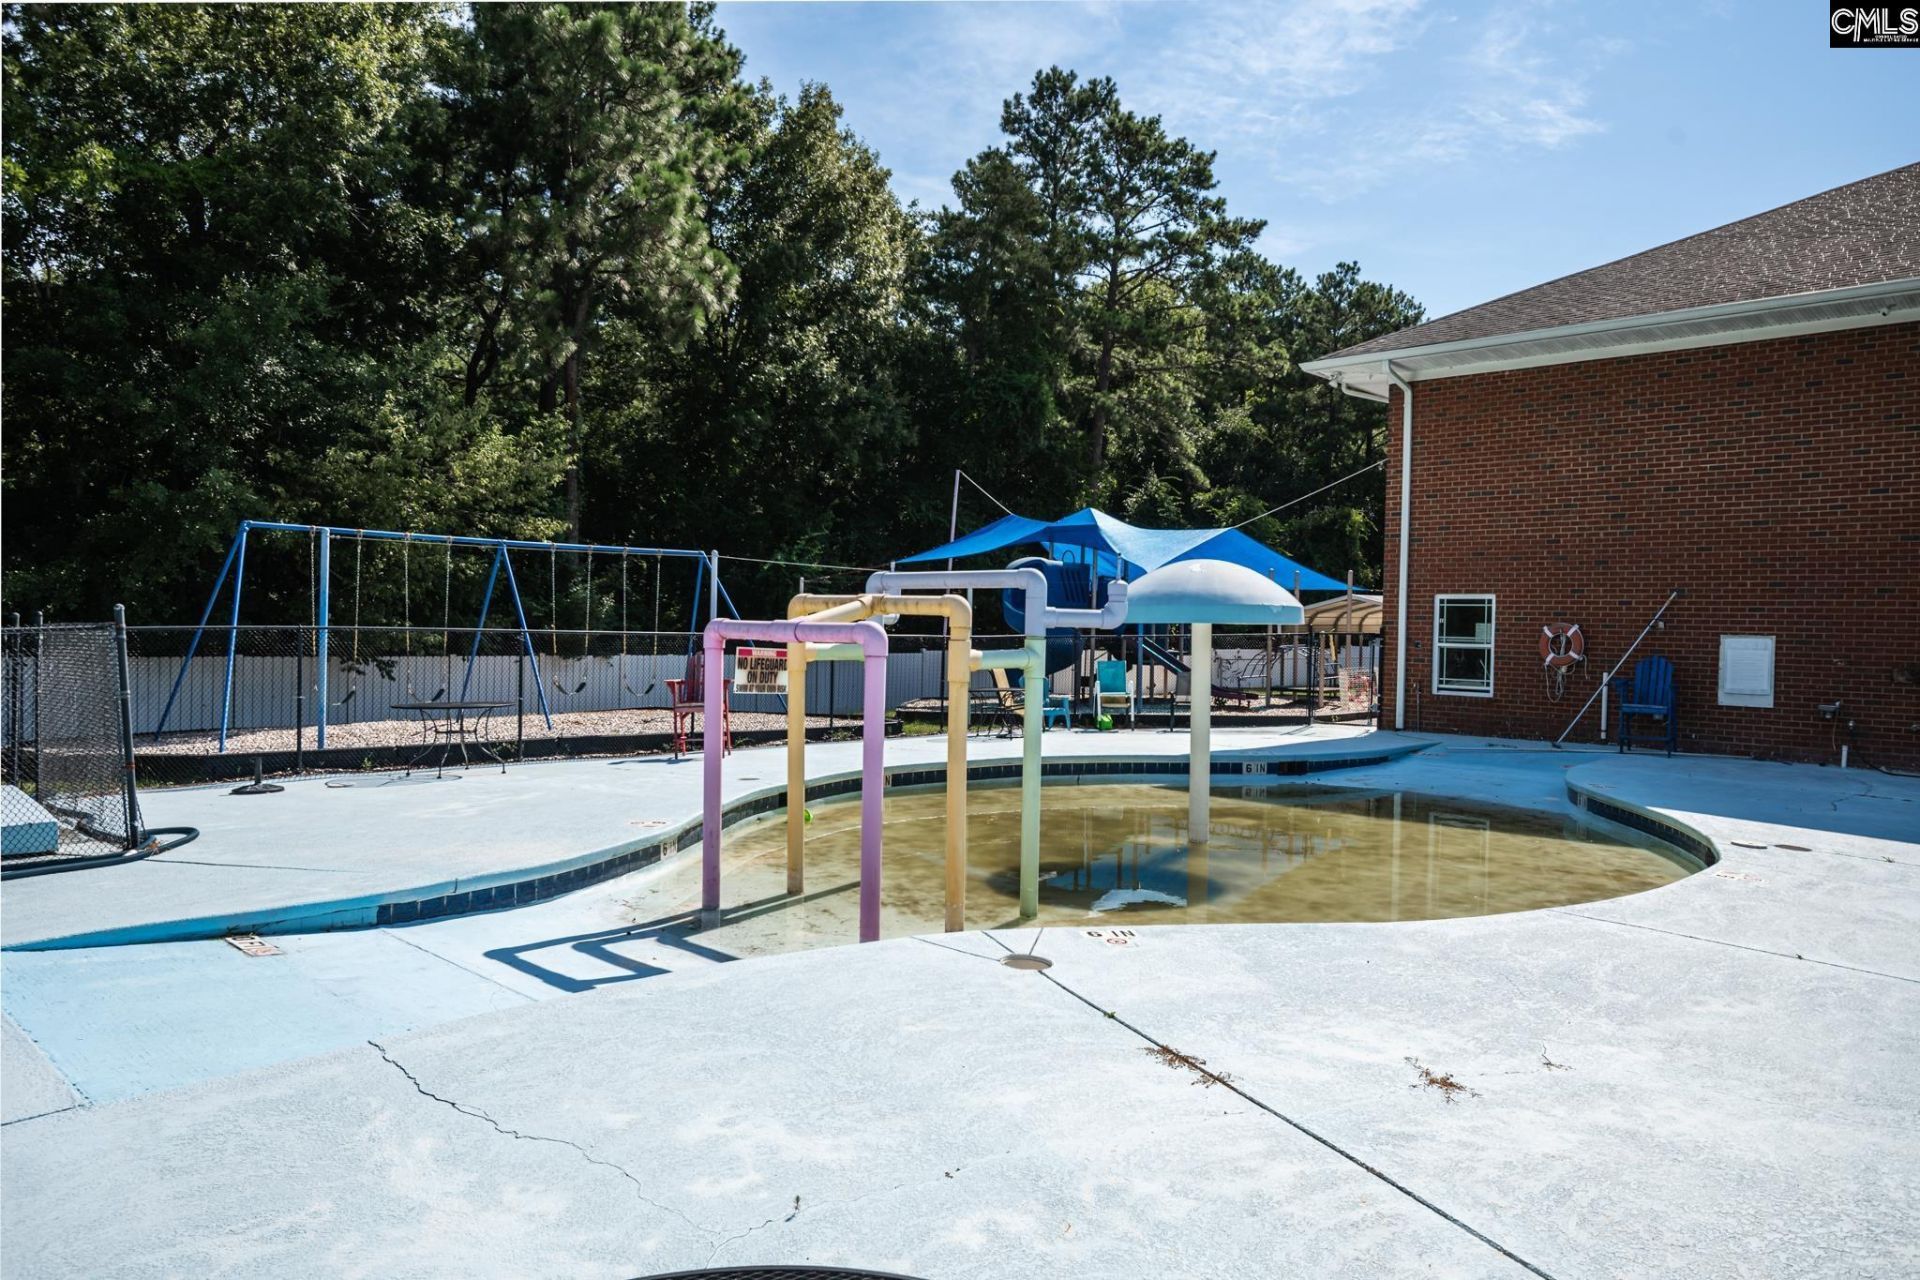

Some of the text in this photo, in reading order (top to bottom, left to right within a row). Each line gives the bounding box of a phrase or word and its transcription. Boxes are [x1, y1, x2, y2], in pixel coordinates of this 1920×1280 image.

[737, 657, 748, 669] NO
[747, 671, 778, 684] ON DUTY
[1246, 763, 1265, 773] 6 IN
